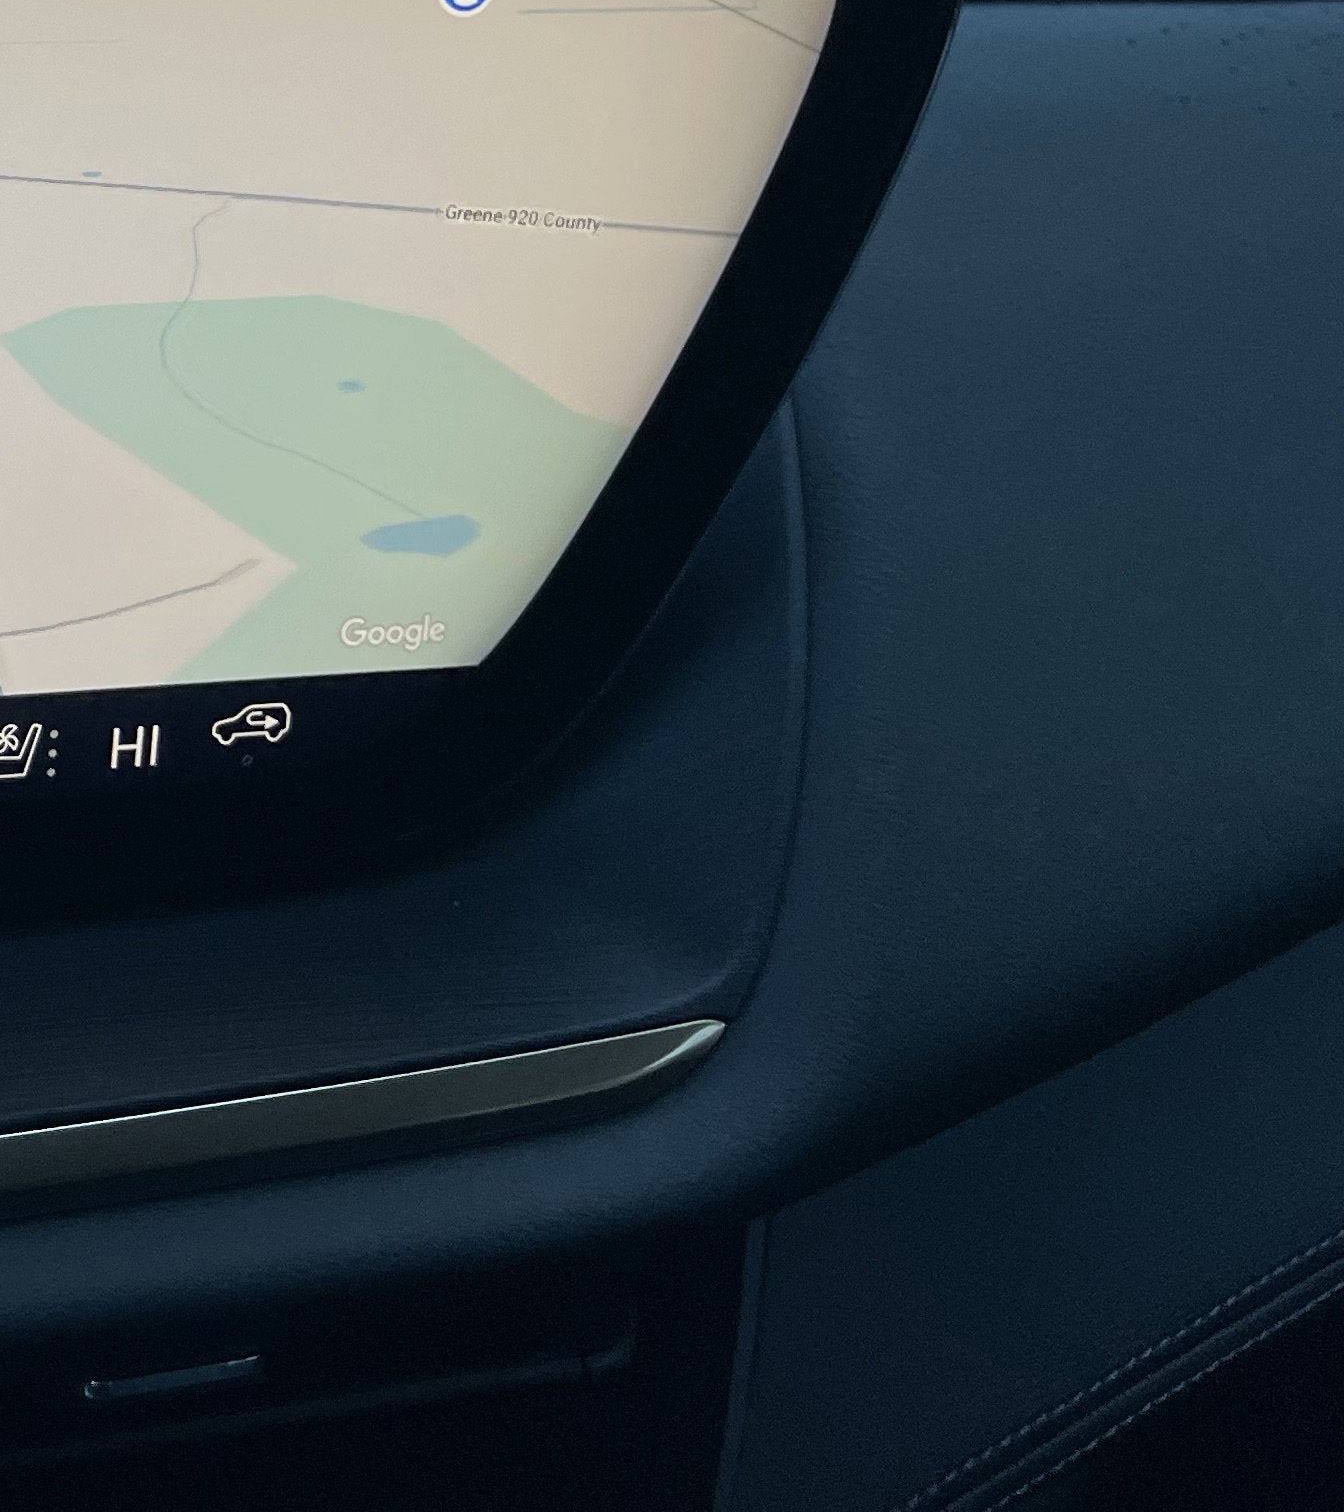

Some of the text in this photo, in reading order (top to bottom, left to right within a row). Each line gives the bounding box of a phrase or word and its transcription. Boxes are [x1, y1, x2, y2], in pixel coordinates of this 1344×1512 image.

[445, 203, 601, 234] Greene 920 County
[340, 613, 446, 651] Google
[110, 725, 160, 769] HI
